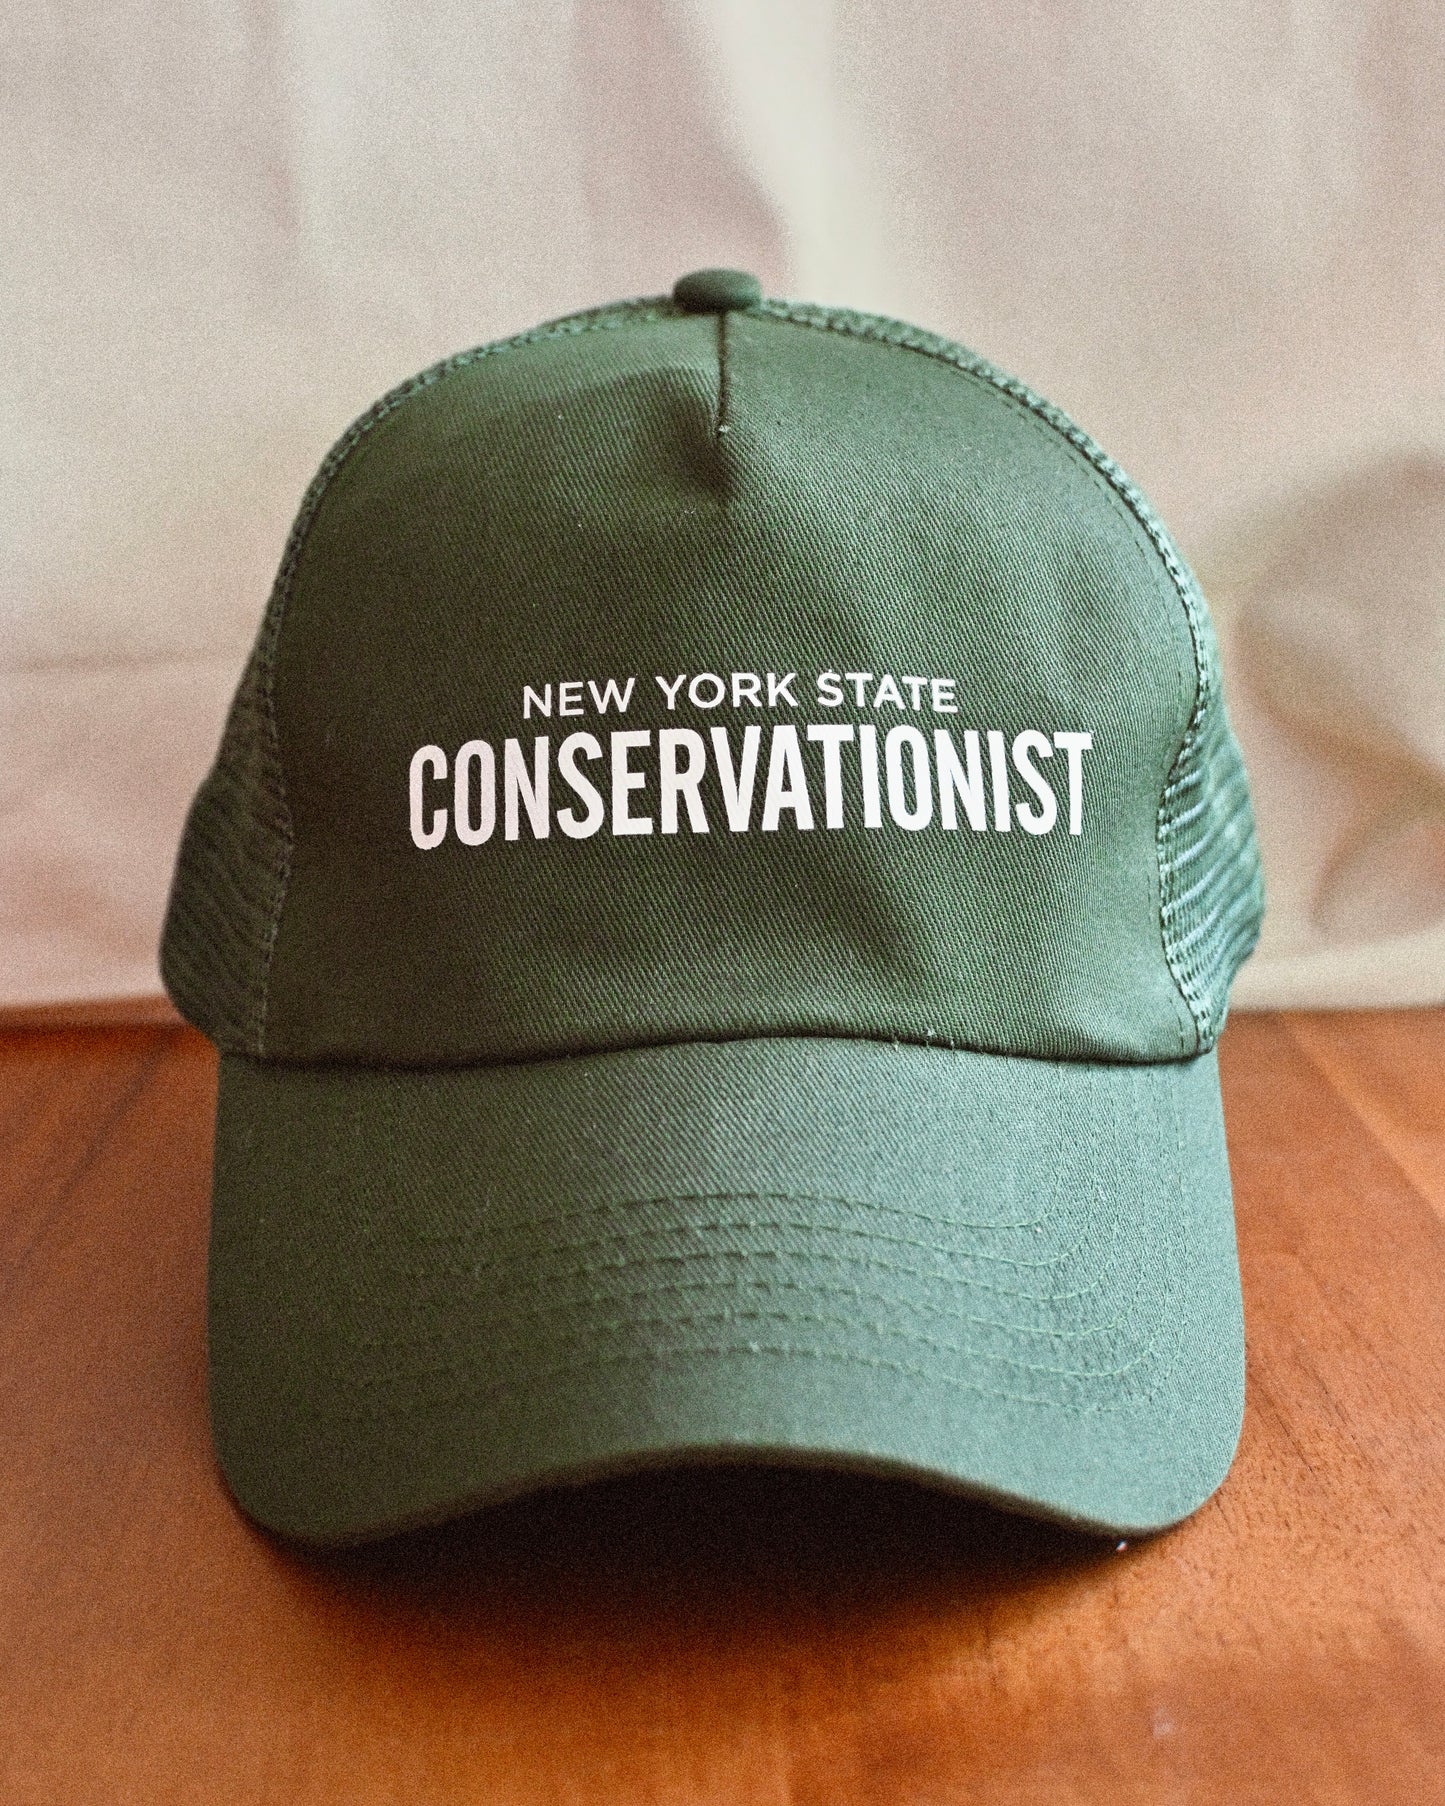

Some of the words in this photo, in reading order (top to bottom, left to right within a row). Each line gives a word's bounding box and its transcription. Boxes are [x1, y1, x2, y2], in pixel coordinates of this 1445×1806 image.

[522, 677, 636, 720] NEW
[654, 671, 798, 709] YORK
[816, 671, 958, 715] STATE
[408, 723, 1093, 851] CONSERVATIONIST
